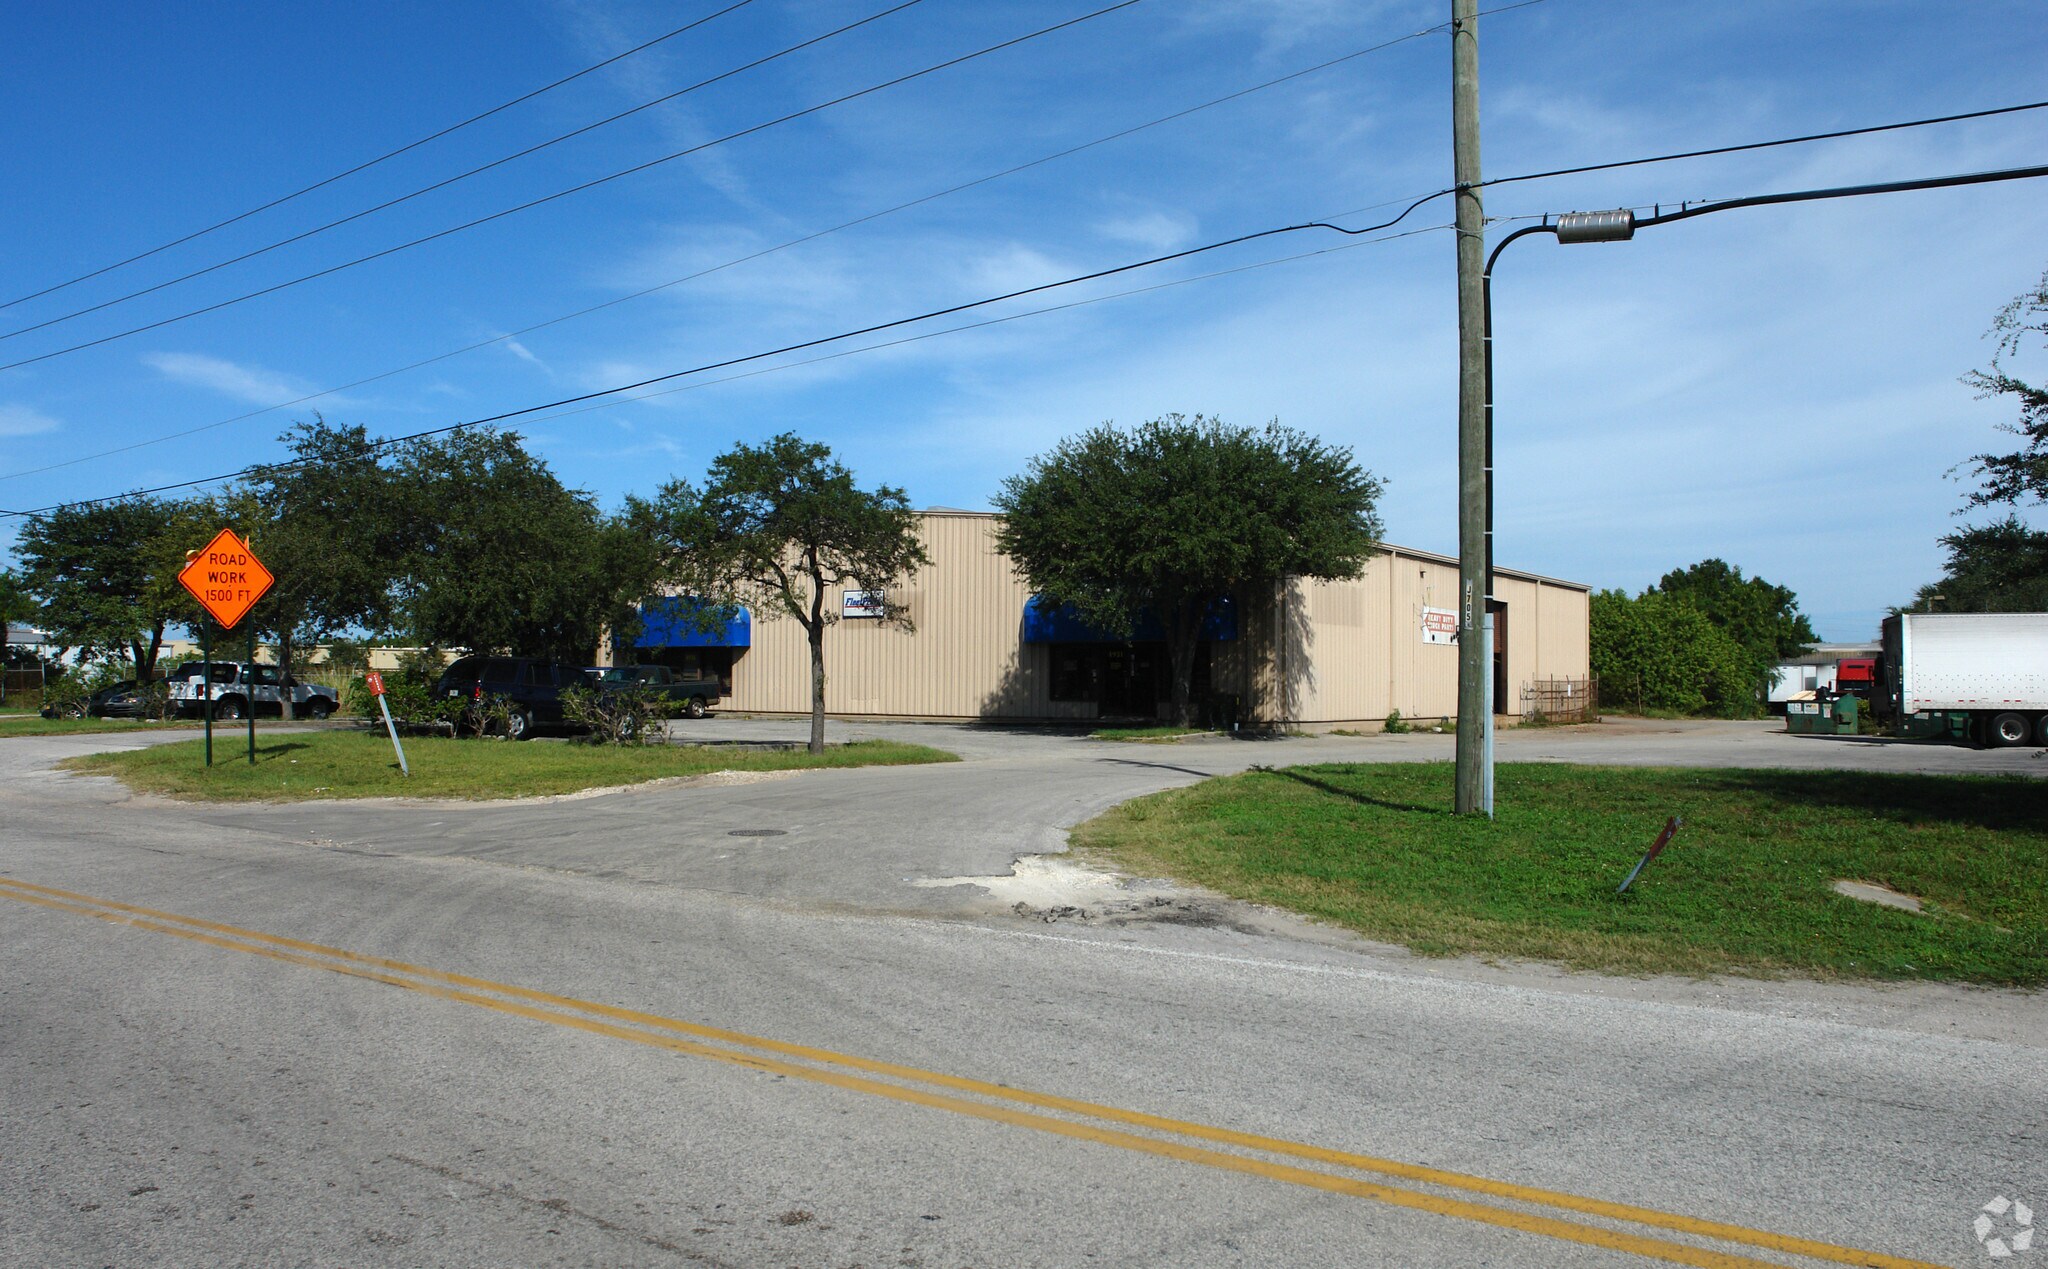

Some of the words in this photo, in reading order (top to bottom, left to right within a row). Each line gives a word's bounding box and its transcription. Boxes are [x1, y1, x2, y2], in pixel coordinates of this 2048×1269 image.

[209, 553, 247, 566] ROAD
[208, 571, 247, 584] WORK
[205, 589, 233, 602] 1500
[238, 590, 251, 602] FT
